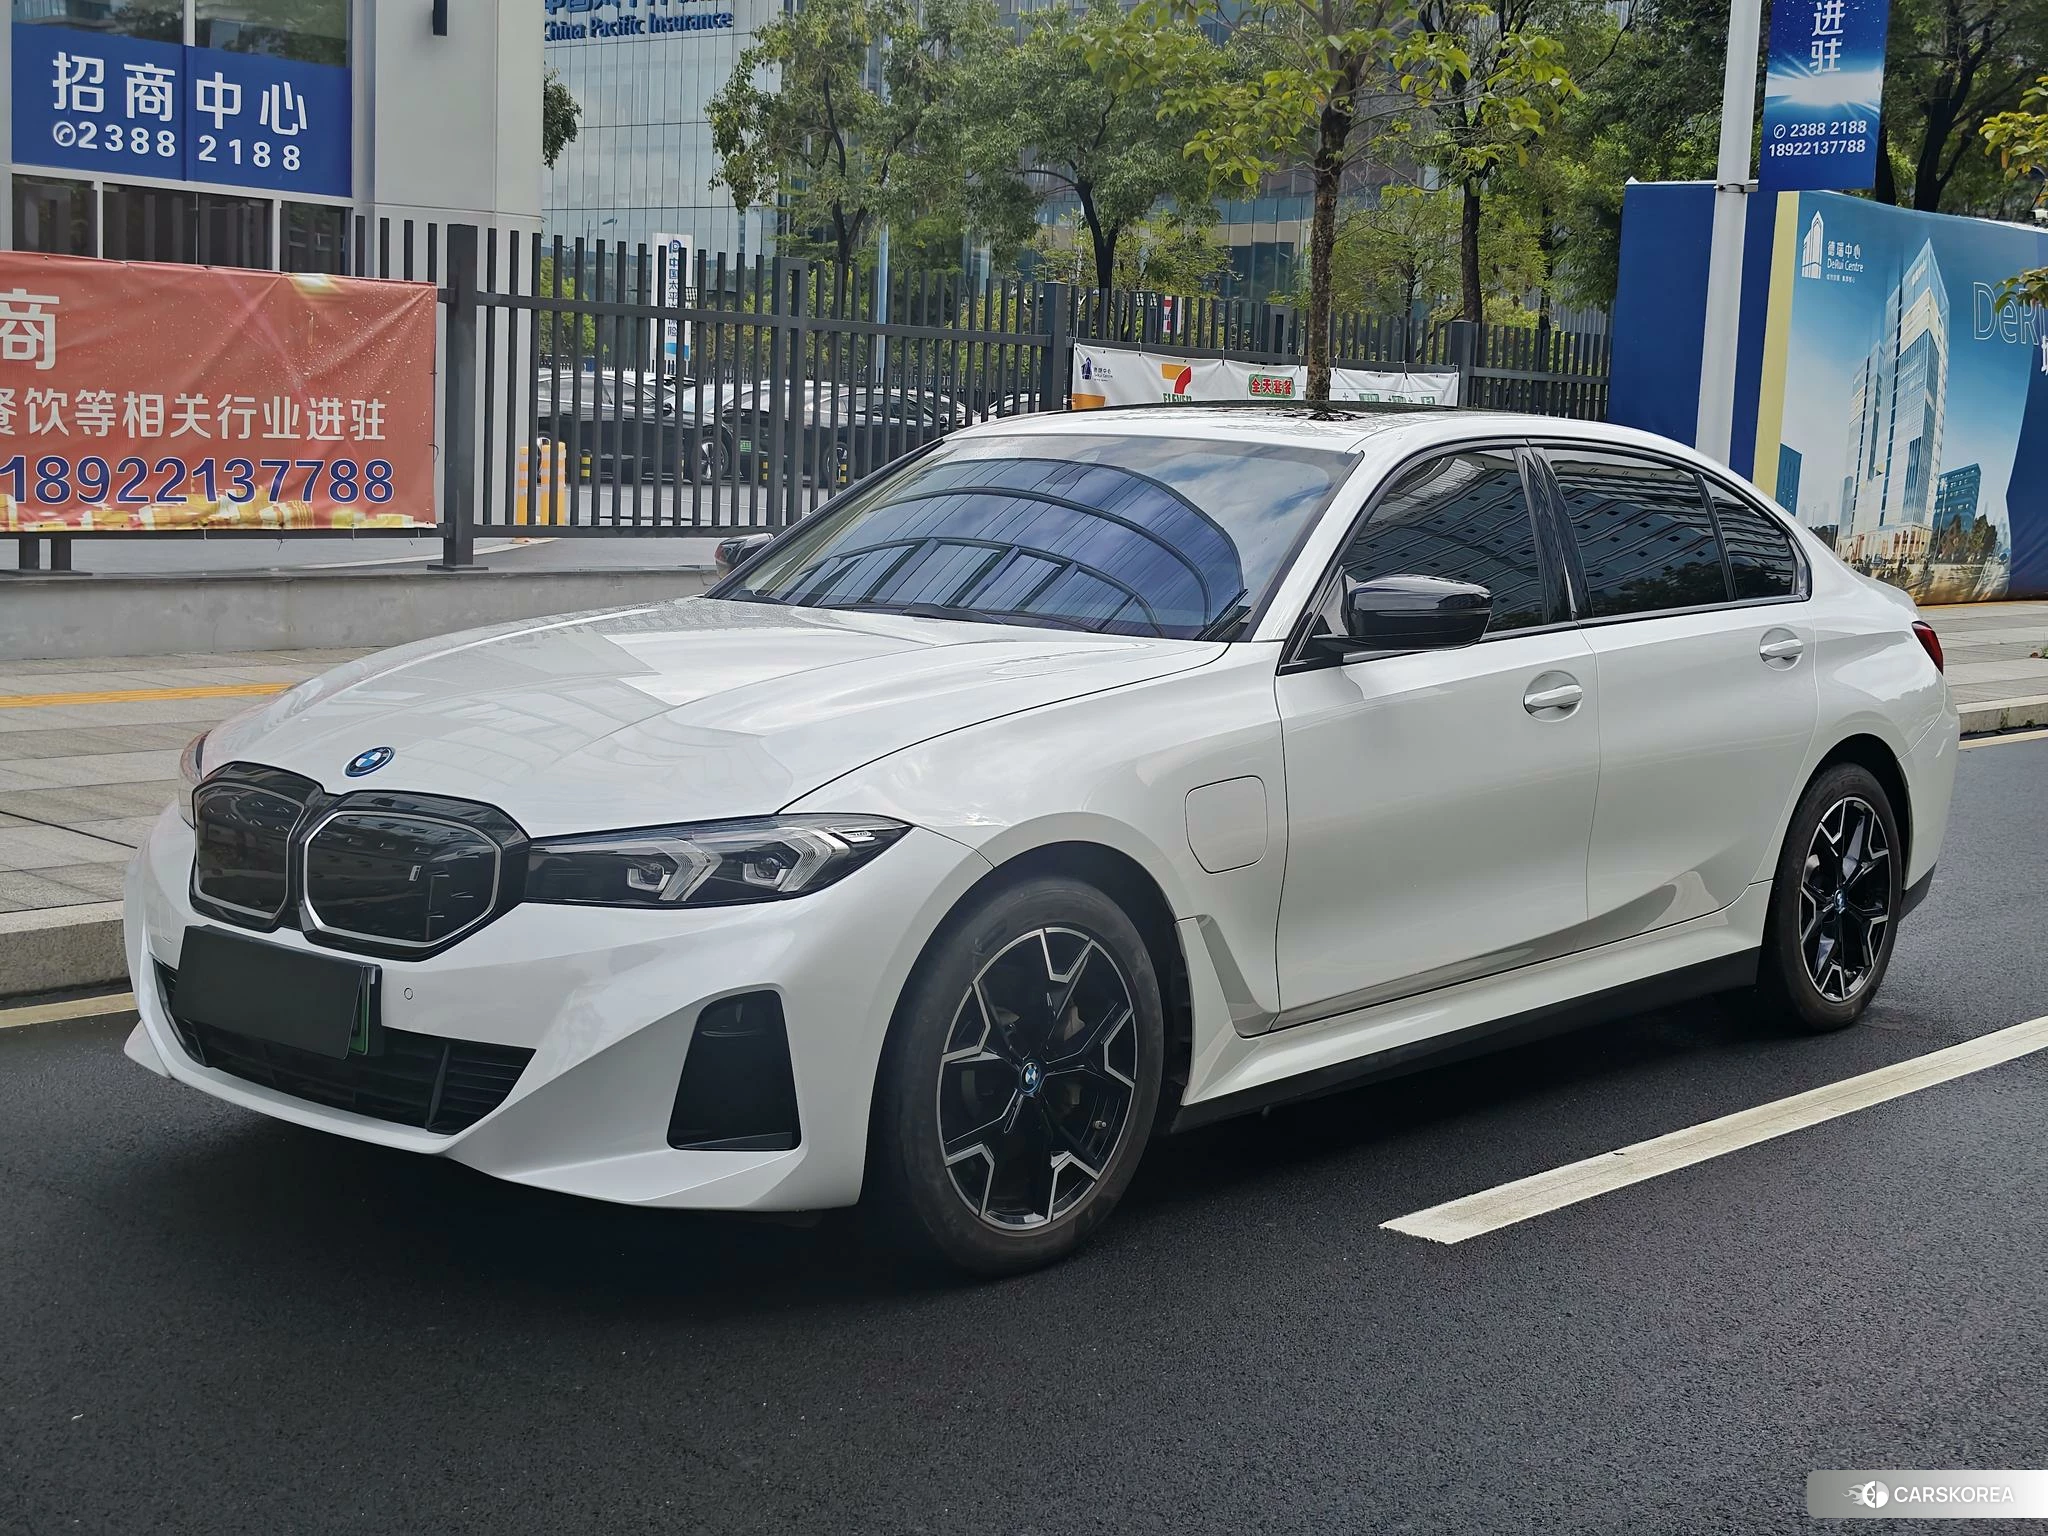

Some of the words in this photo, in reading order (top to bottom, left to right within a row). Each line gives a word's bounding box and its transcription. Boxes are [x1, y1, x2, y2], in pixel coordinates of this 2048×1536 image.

[589, 15, 645, 38] Pacific
[650, 12, 734, 33] Insurance
[1809, 0, 1845, 74] 进驻
[52, 51, 308, 136] 招商中心
[77, 120, 176, 158] 2388
[198, 135, 300, 171] 2188
[1768, 139, 1866, 157] 18922137788
[1789, 122, 1826, 138] 2388
[1829, 120, 1867, 136] 2188
[1844, 260, 1864, 273] Centre
[0, 288, 60, 370] 商
[0, 455, 395, 505] 18922137788
